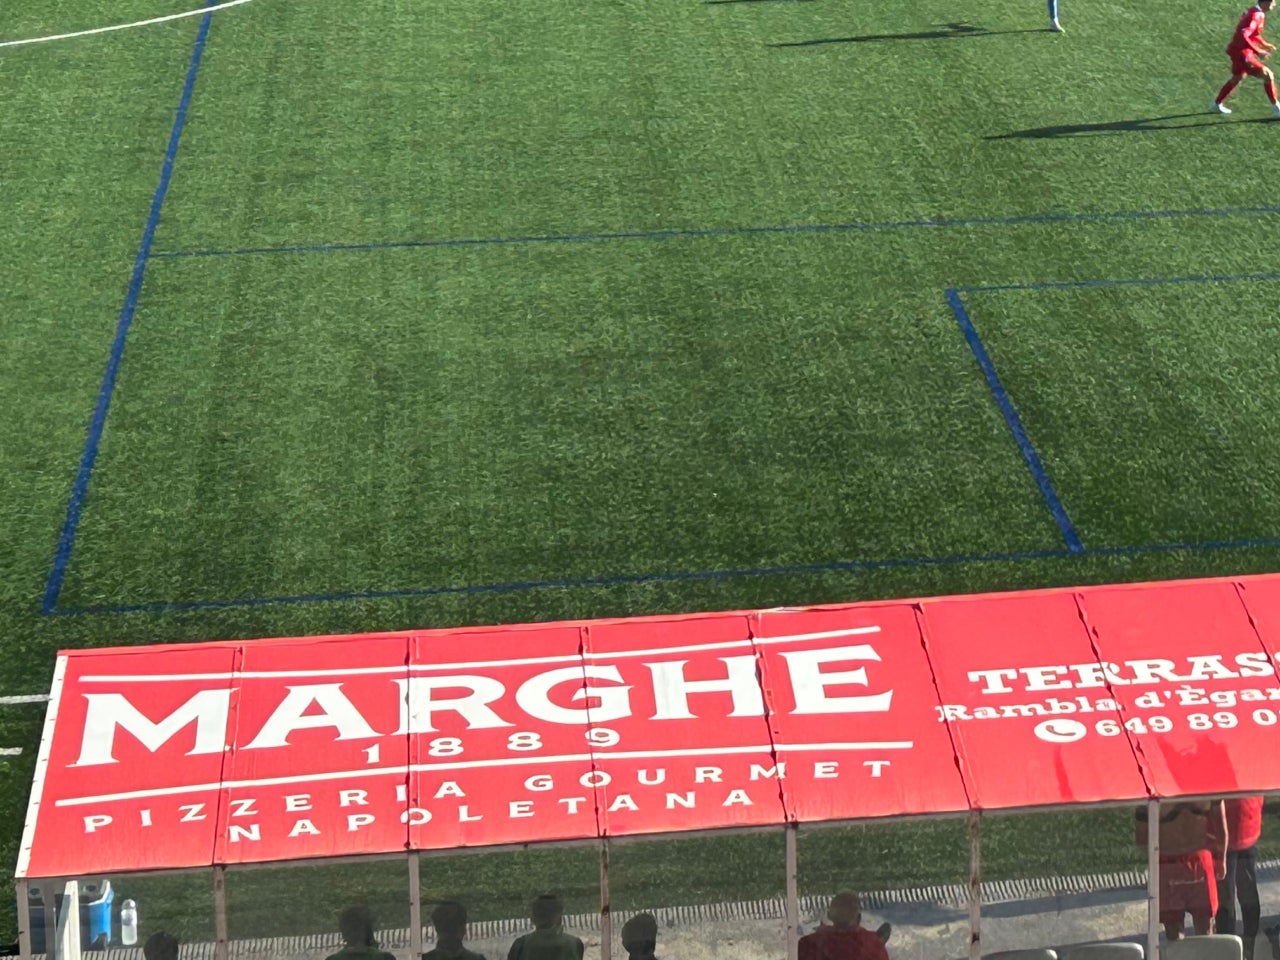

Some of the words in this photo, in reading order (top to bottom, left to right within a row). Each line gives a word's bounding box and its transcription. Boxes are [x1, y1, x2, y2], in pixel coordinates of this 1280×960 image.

[65, 644, 894, 768] MARGHE
[934, 694, 1122, 723] Rambla
[1095, 714, 1174, 738] 649
[1187, 711, 1239, 731] 89
[361, 726, 621, 764] 1889
[83, 780, 467, 833] PIZZERIA
[524, 760, 891, 792] GOURMET
[229, 788, 754, 843] NAPOLETANA
